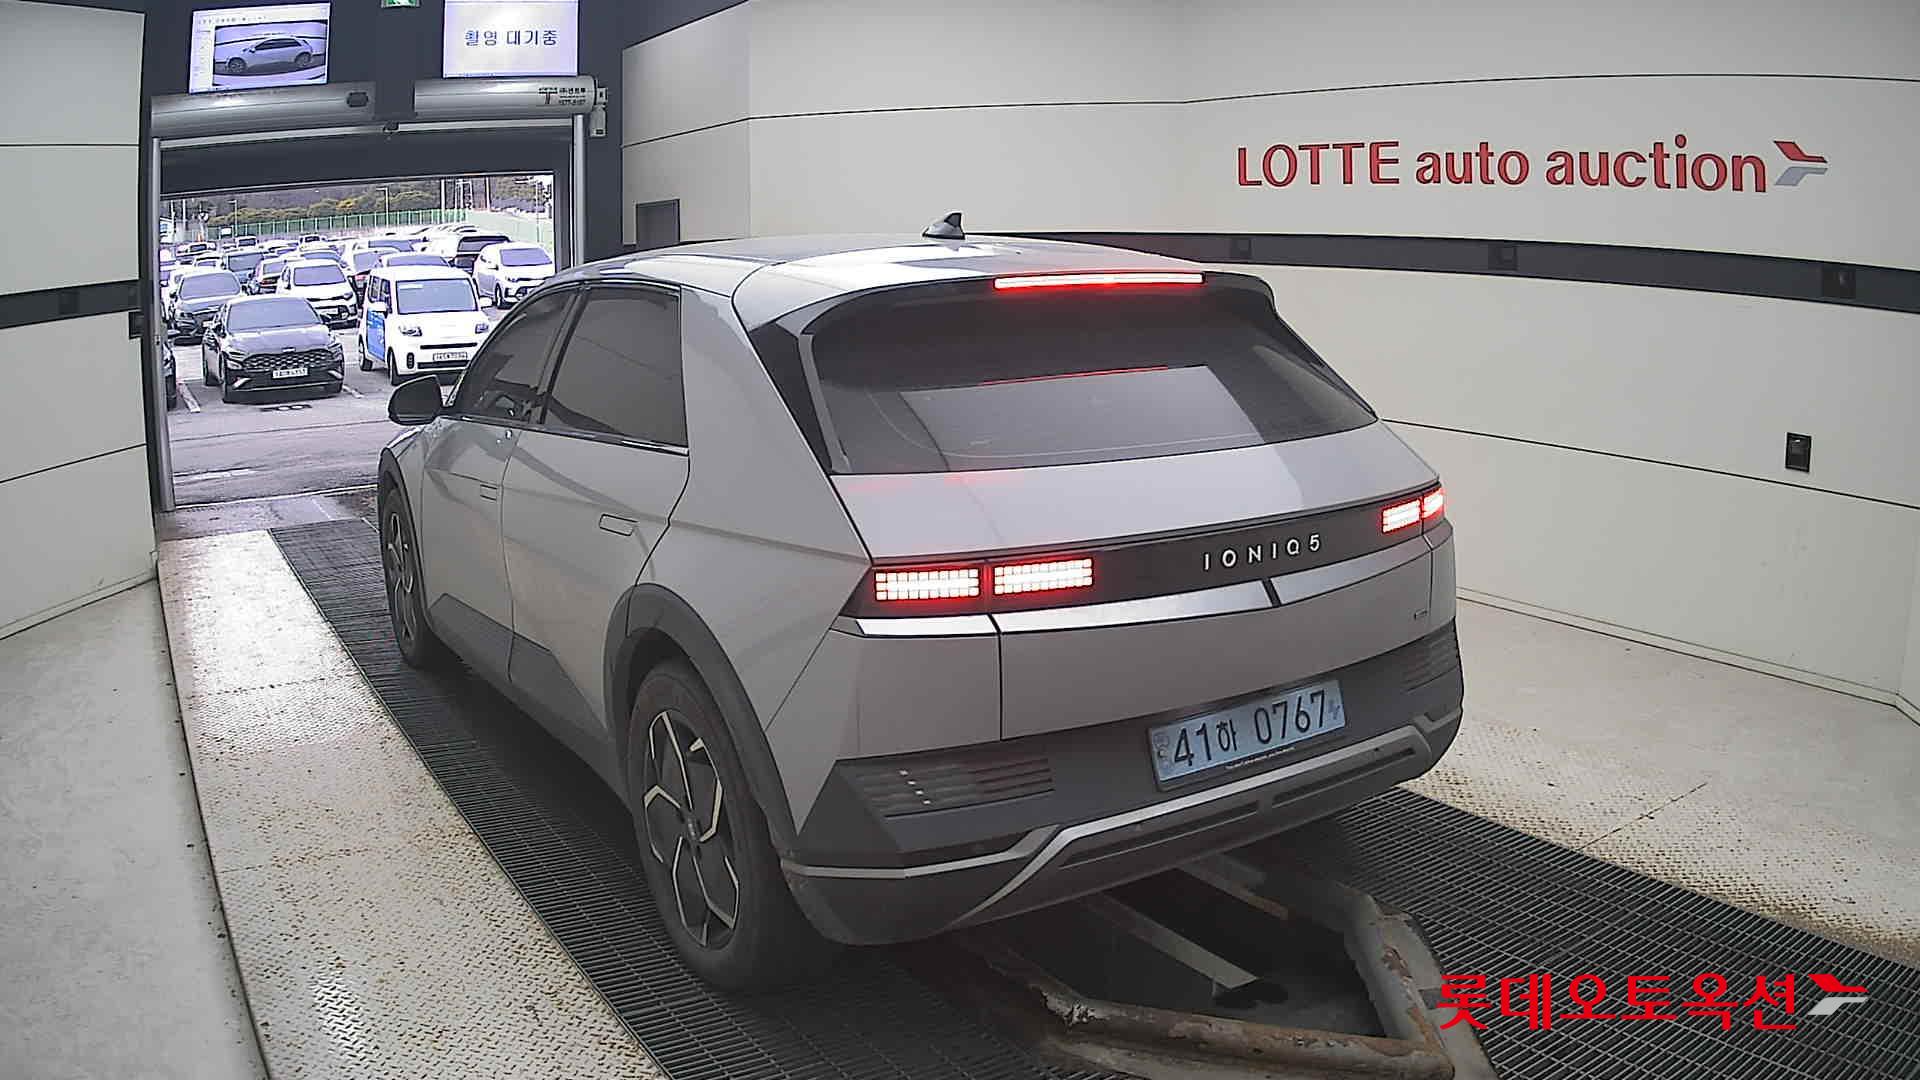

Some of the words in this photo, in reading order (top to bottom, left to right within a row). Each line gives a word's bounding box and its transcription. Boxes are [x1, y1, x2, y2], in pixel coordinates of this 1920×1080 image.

[464, 29, 498, 47] 촬영
[506, 29, 558, 47] 대기중
[1236, 141, 1400, 188] LOTTE
[1415, 141, 1531, 186] auto
[1545, 134, 1768, 193] auction
[1253, 688, 1326, 745] 0767
